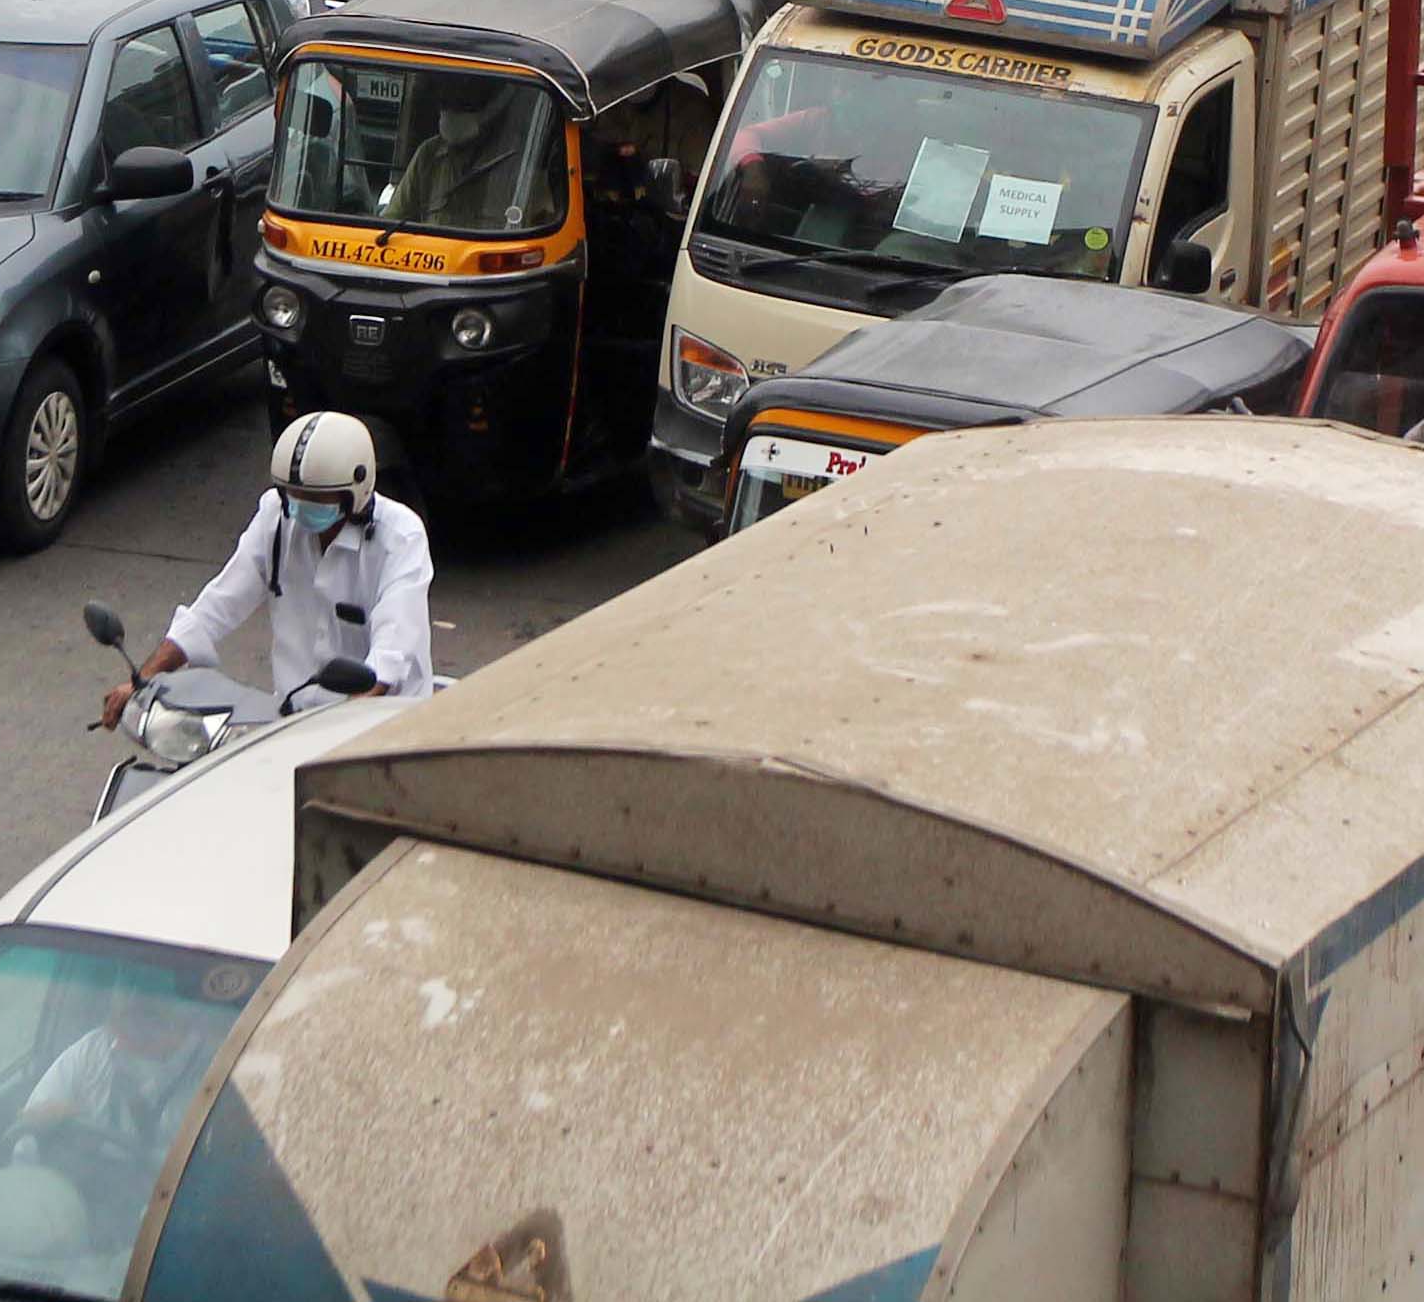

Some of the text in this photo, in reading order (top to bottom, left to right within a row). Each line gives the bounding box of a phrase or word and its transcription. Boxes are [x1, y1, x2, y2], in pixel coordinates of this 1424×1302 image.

[957, 51, 1072, 84] CARRIER
[999, 187, 1048, 204] MEDICAL
[999, 204, 1041, 219] SUPPLY
[311, 239, 445, 272] MH.47.C.4796
[356, 324, 380, 340] RE
